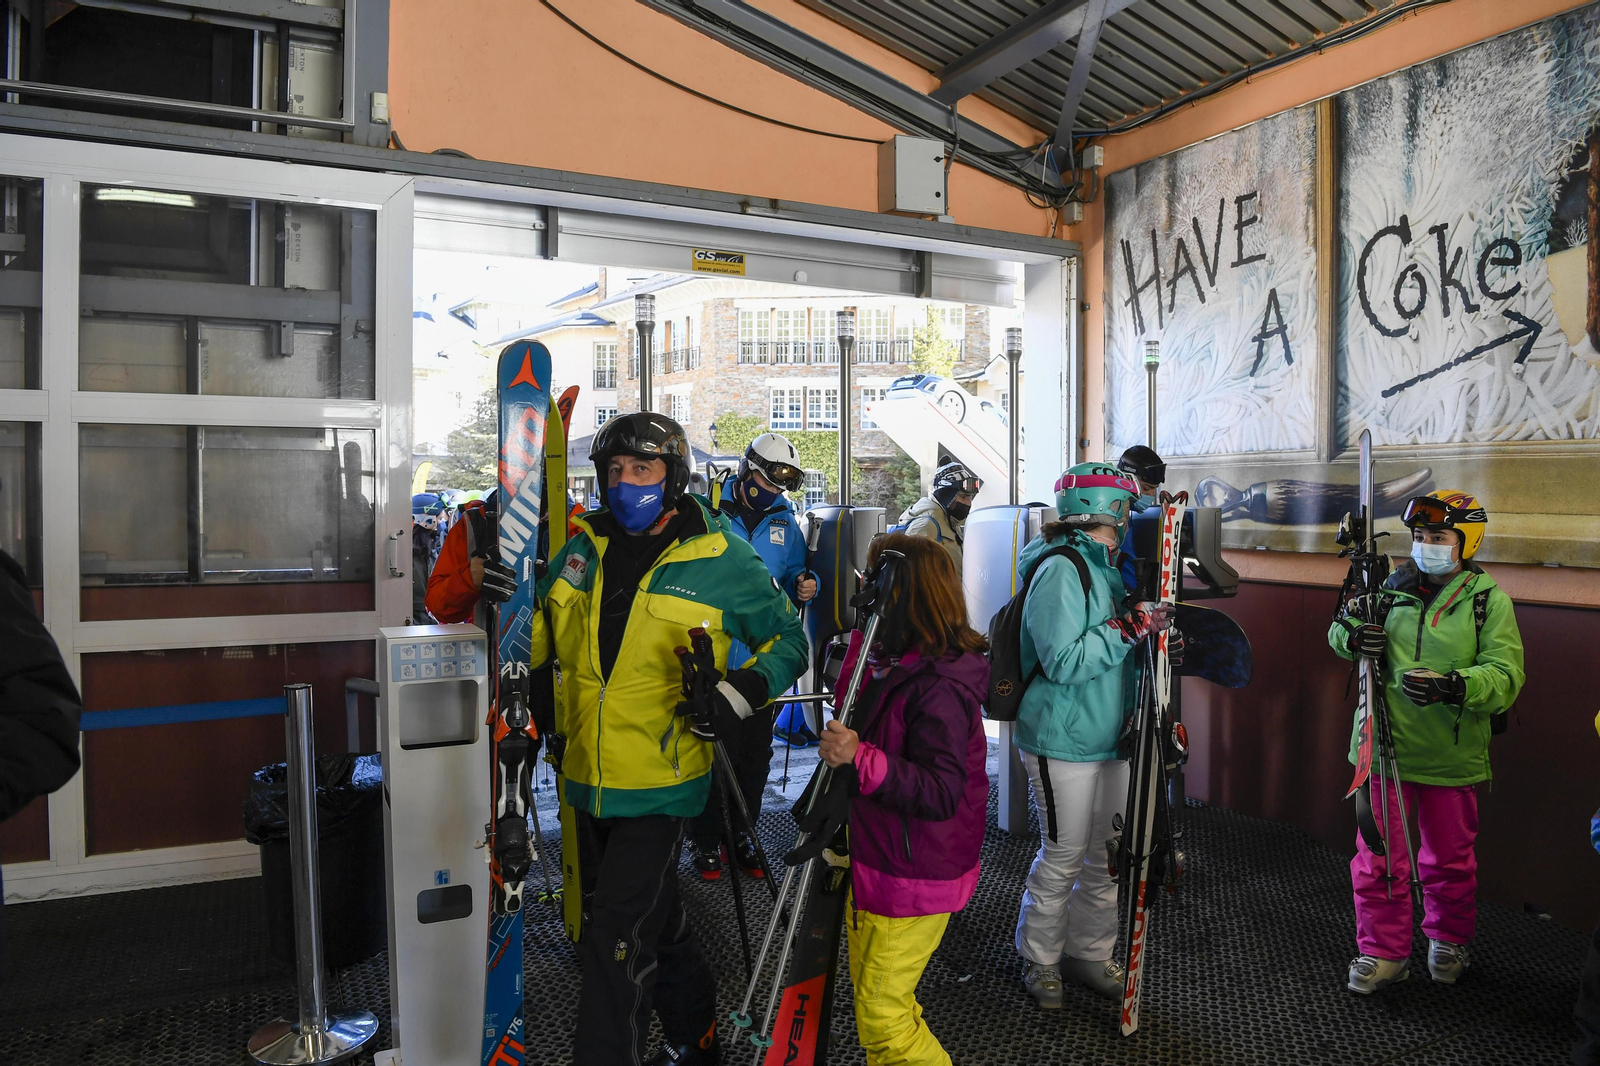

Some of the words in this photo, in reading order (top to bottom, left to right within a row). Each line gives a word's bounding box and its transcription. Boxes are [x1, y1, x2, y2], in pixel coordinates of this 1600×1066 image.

[697, 266, 741, 275] www.gsvial.com
[1119, 190, 1267, 336] HAVE
[1249, 287, 1295, 378] A
[507, 1016, 523, 1036] 176
[785, 993, 810, 1066] HEA
